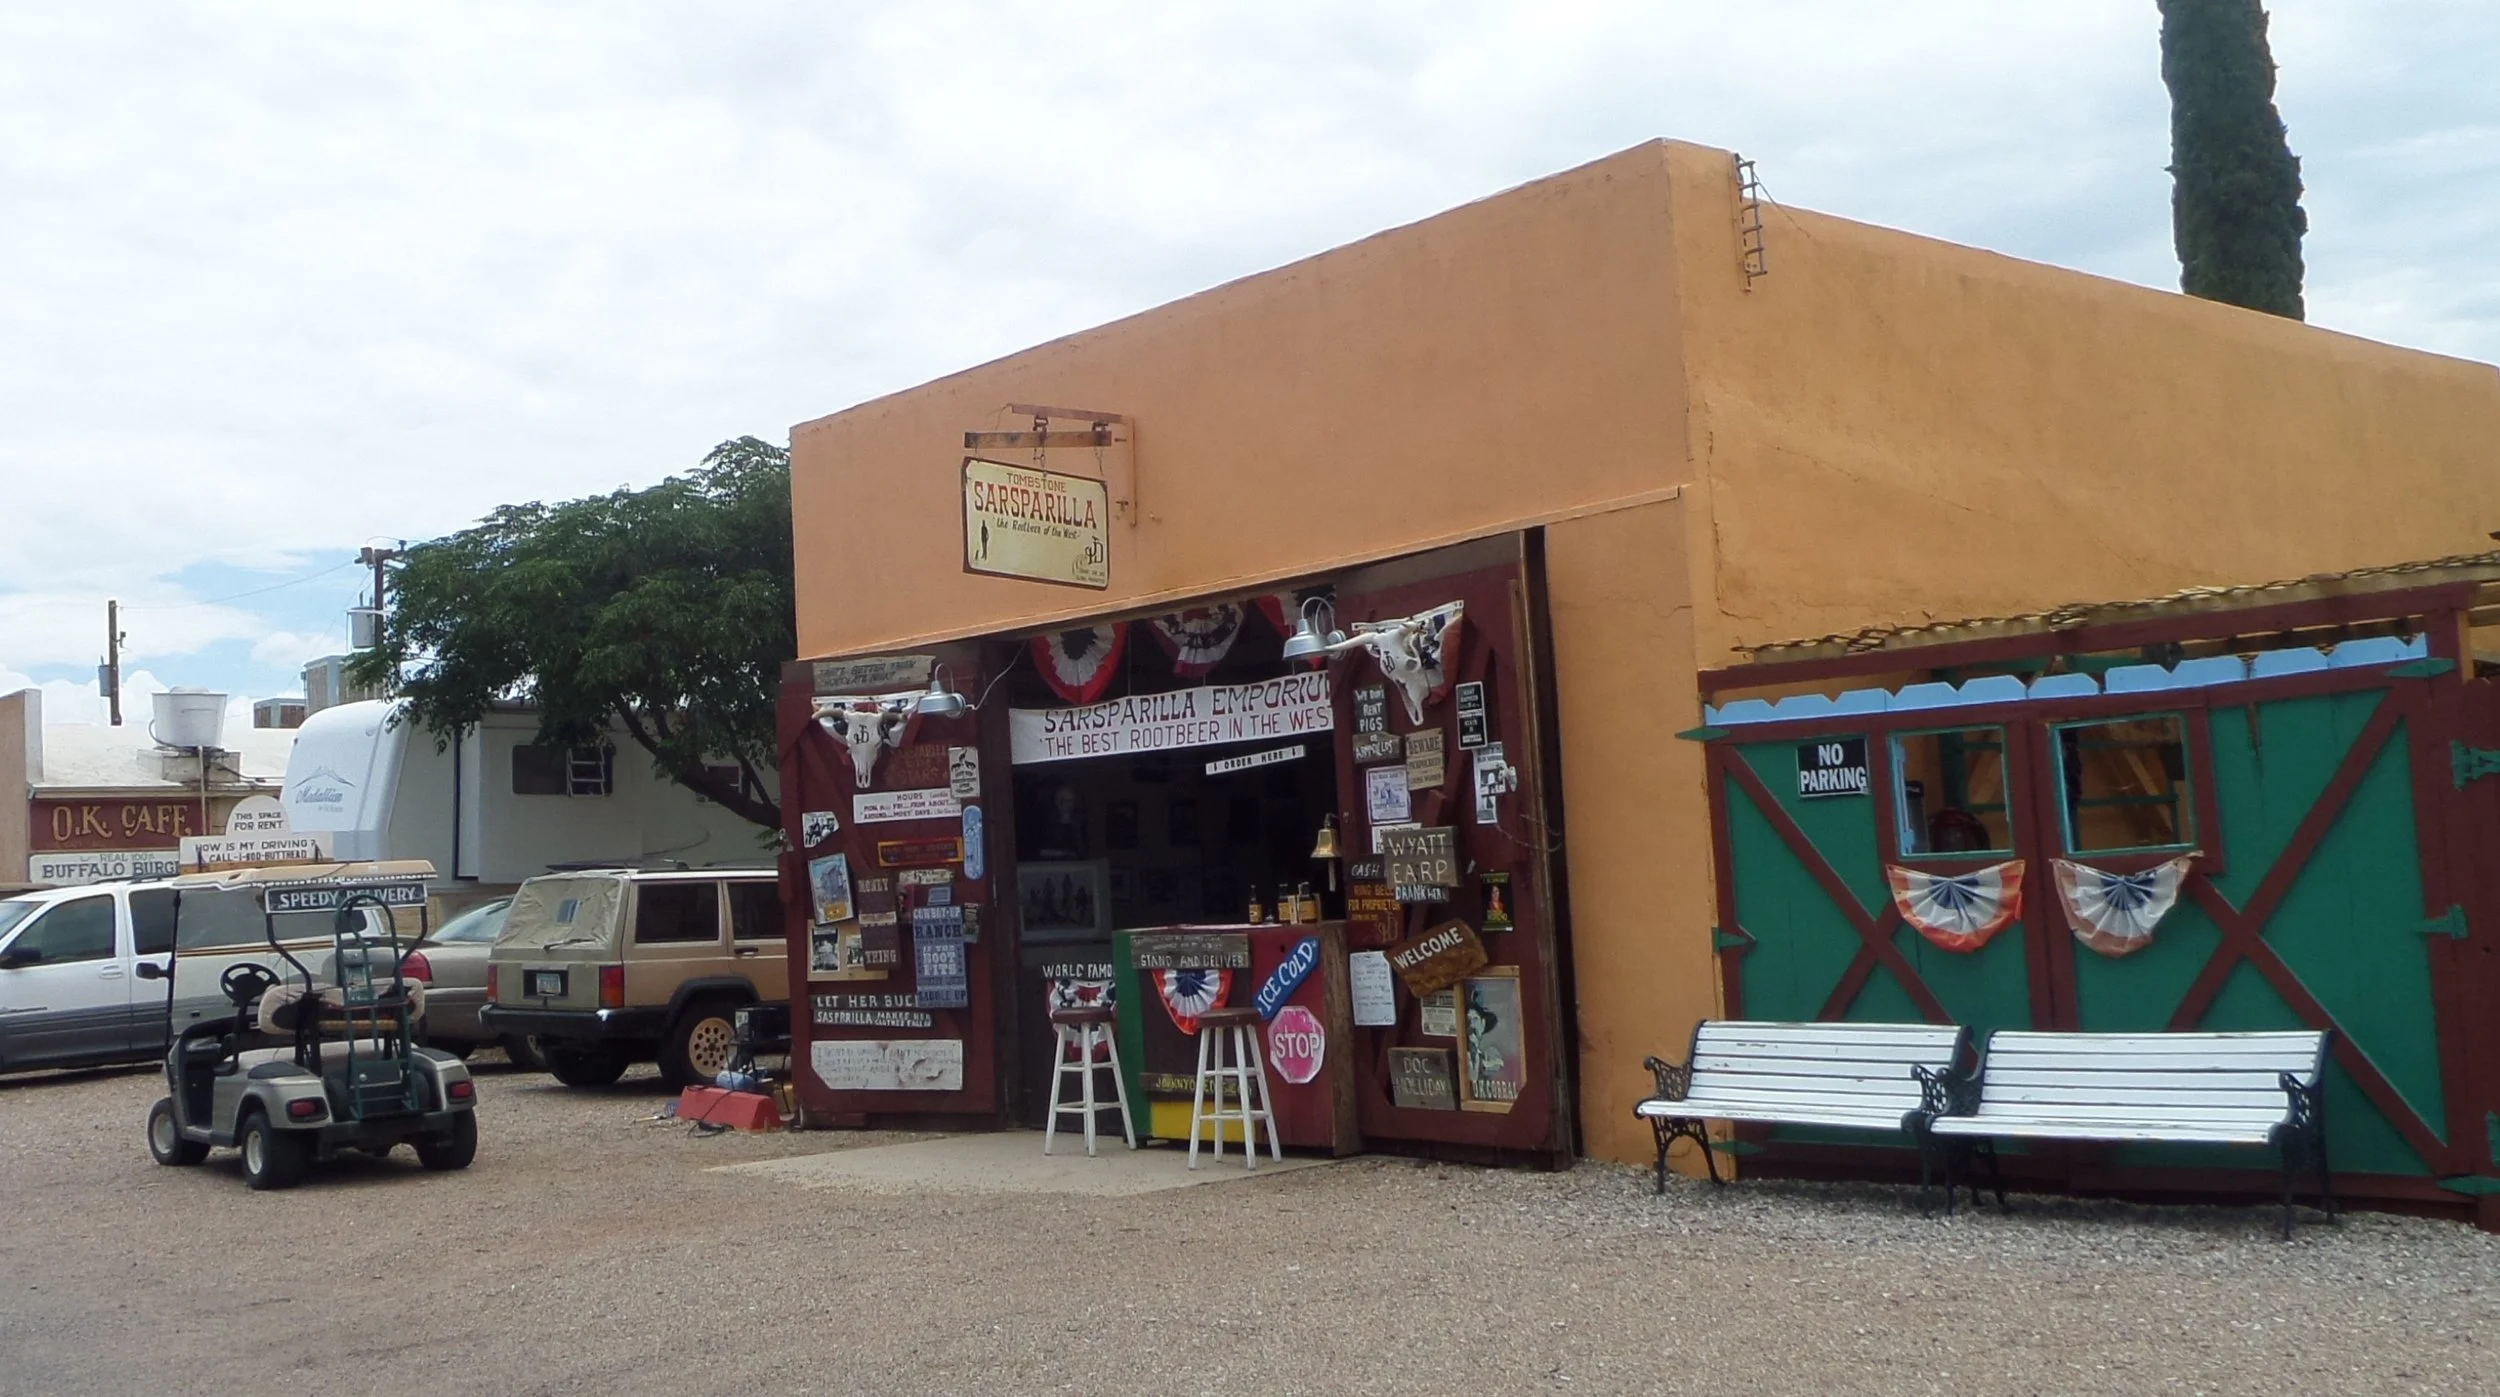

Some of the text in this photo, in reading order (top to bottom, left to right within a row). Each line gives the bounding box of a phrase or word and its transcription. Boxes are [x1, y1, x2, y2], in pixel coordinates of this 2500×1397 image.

[1006, 473, 1067, 493] TOMBSTONE
[974, 481, 1097, 530] SARSPARILLA
[1044, 692, 1196, 733] SARSPARILLA
[1363, 703, 1382, 716] RENT
[1081, 731, 1120, 754] BEST
[1131, 721, 1220, 749] ROOTBEER
[1229, 716, 1242, 739] IN
[1250, 712, 1280, 736] THE
[1360, 716, 1383, 732] PIGS
[1224, 750, 1283, 770] ORDER HERE
[1818, 743, 1844, 766] NO
[1800, 766, 1867, 792] PARKING
[896, 793, 923, 801] HOURS
[52, 805, 192, 841] O.K. CAFE
[235, 812, 253, 820] THIS
[234, 820, 284, 831] FOR RENT
[195, 843, 222, 852] HOW
[226, 842, 235, 851] IS
[240, 841, 255, 850] MY
[1388, 834, 1446, 857] WYATT
[100, 853, 128, 862] REAL
[42, 862, 125, 878] BUFFALO
[1351, 864, 1380, 877] CASH
[1392, 859, 1447, 883] EARP
[279, 890, 338, 908] SPEEDY
[1394, 927, 1464, 969] WELCOME
[1140, 954, 1244, 967] STAND AND DELIVER
[1042, 963, 1115, 978] WORLD FAMO
[1257, 942, 1314, 1012] ICE COLD
[817, 996, 839, 1008] LET
[849, 995, 878, 1008] HER
[1274, 1032, 1320, 1058] STOP
[1403, 1057, 1431, 1074] DOC
